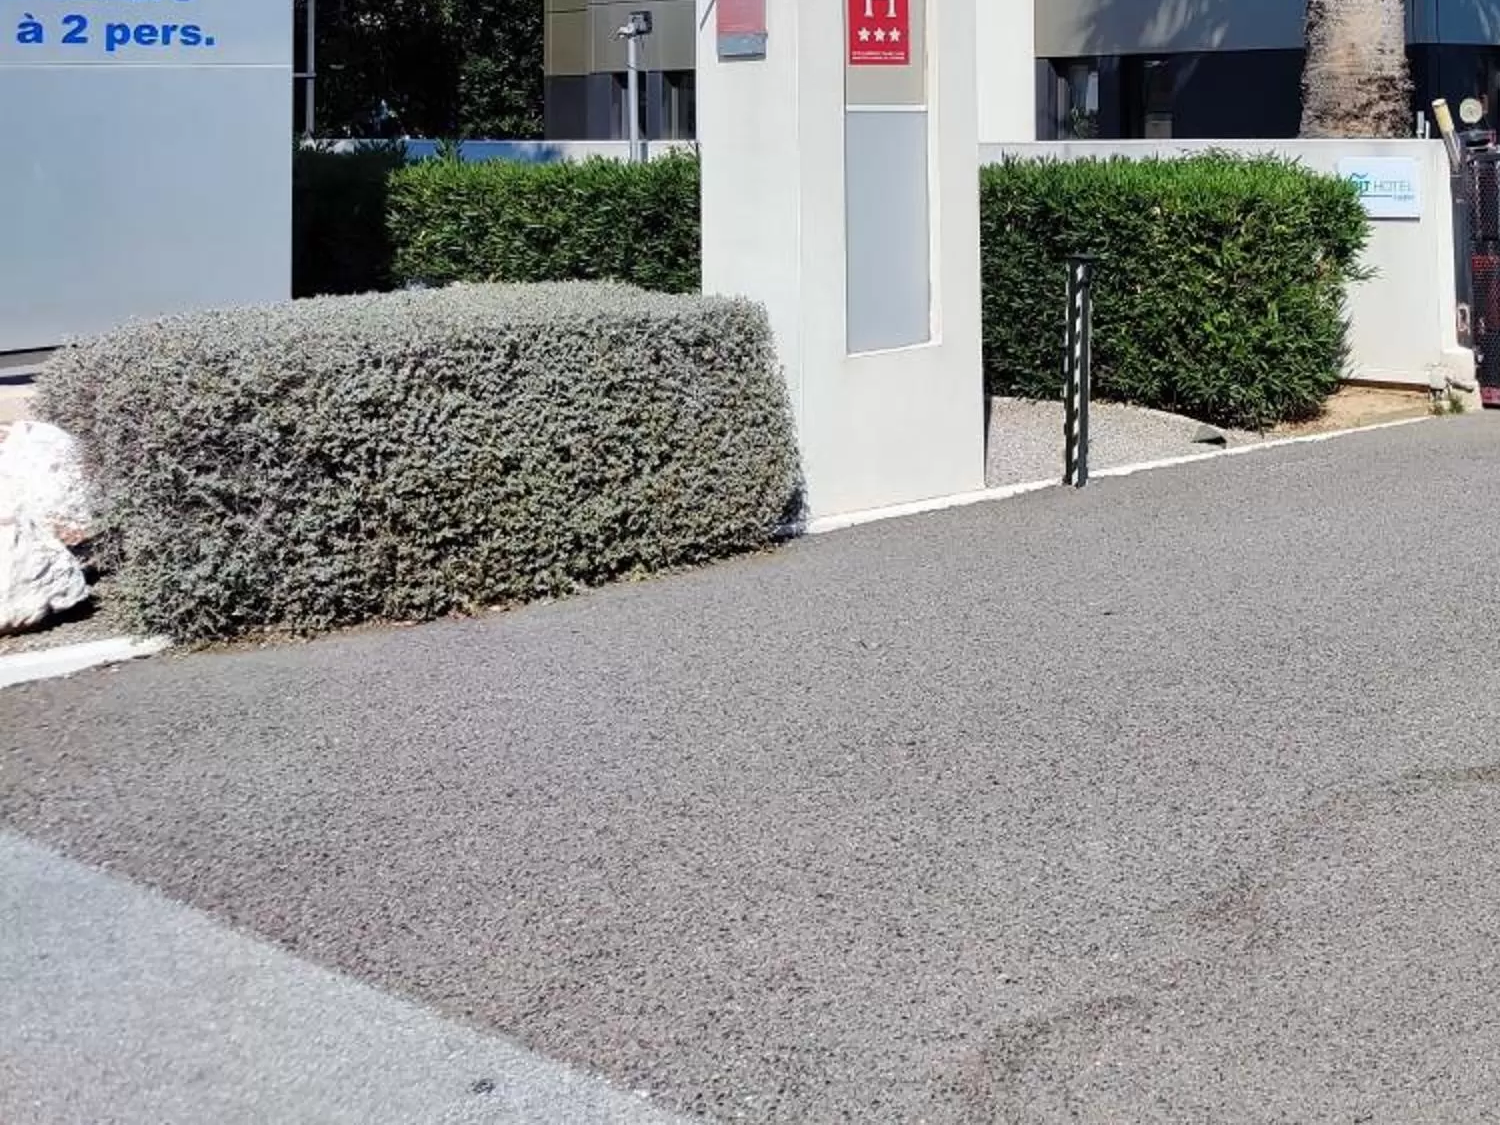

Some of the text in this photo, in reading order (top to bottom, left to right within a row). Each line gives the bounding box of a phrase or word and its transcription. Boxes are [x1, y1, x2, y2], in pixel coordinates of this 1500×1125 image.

[17, 12, 215, 52] à 2 pers.
